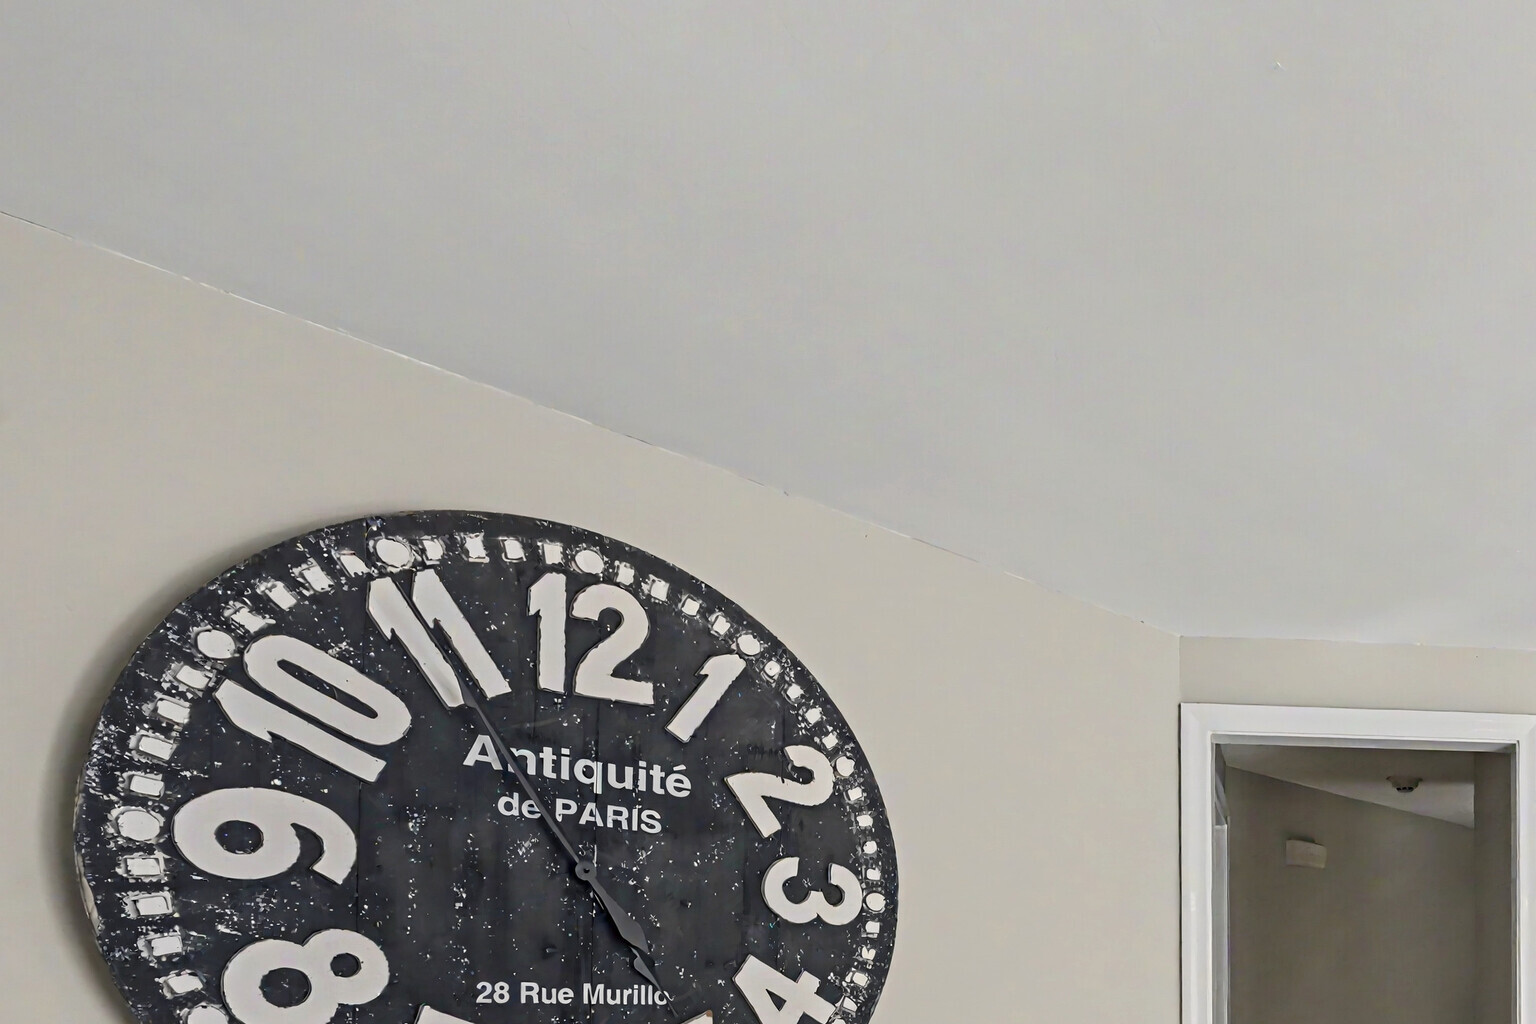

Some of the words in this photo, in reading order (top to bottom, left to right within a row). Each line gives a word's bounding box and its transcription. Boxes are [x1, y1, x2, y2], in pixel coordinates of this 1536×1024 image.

[367, 570, 513, 709] 11
[529, 572, 653, 705] 12
[214, 634, 412, 782] 10
[665, 653, 747, 744] 1
[463, 734, 692, 798] Antiquité
[724, 745, 836, 839] 2
[173, 787, 357, 886] 9
[497, 792, 542, 819] de
[556, 798, 662, 833] PARIS
[761, 855, 863, 927] 3
[476, 981, 510, 1004] 28
[520, 982, 574, 1004] Rue
